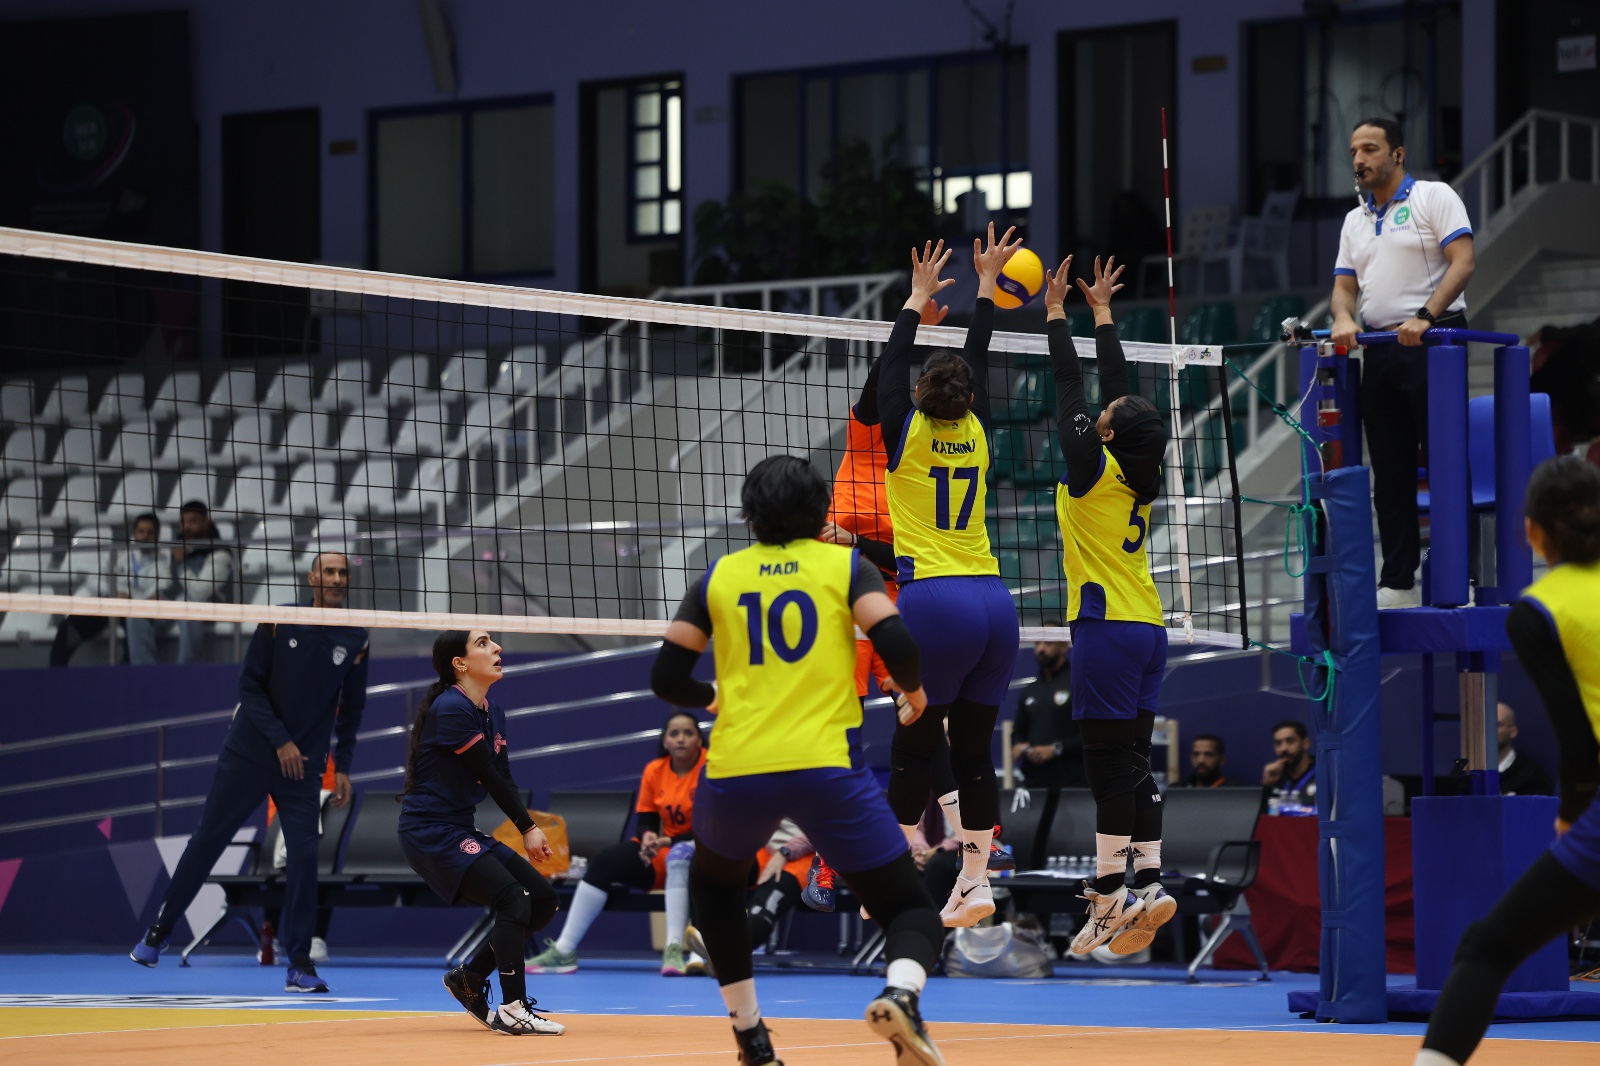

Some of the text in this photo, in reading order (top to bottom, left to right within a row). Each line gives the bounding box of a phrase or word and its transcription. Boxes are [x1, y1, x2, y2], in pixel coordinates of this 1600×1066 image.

[928, 466, 979, 530] 17
[1122, 498, 1146, 553] 5
[759, 561, 799, 576] MADI
[737, 589, 818, 666] 10
[665, 804, 686, 825] 16
